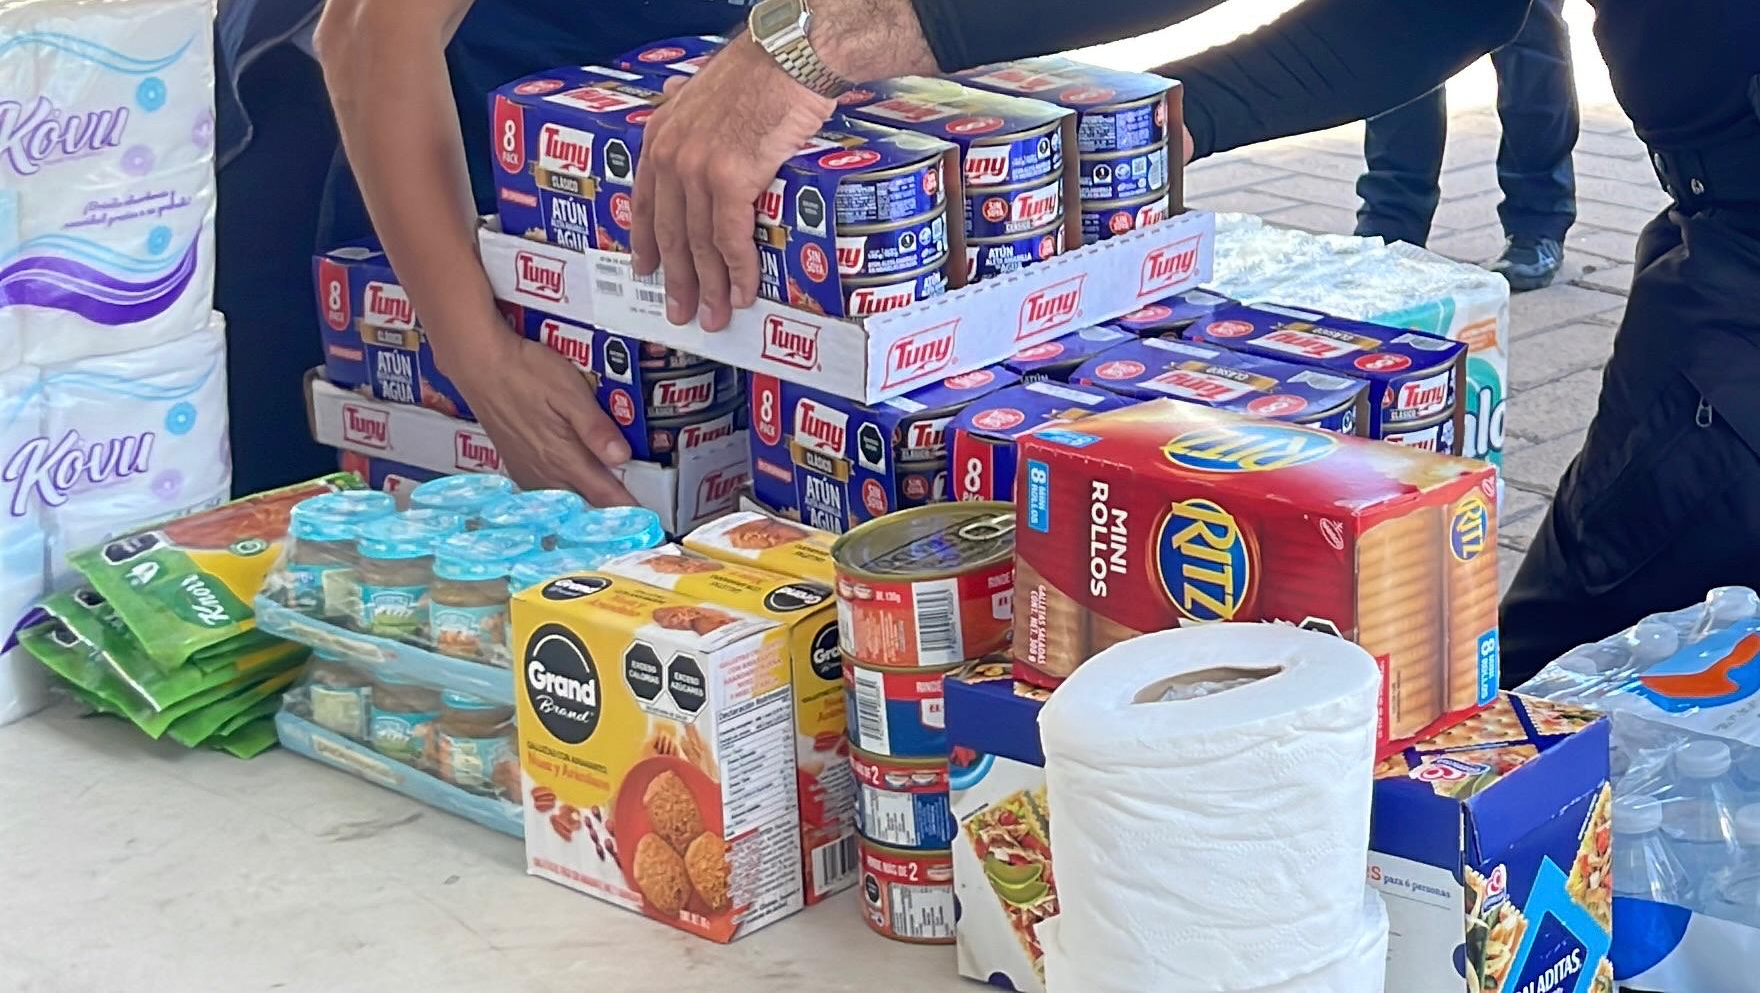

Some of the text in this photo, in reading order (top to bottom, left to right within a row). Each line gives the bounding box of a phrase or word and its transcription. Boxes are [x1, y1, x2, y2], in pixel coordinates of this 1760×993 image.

[503, 119, 516, 152] 8
[544, 126, 591, 173] Tuny
[551, 196, 588, 228] ATÚN
[520, 255, 562, 294] Tuny
[1148, 247, 1200, 284] Tuny
[329, 280, 341, 310] 8
[368, 286, 415, 325] Tuny
[1026, 286, 1082, 325] Tuny
[544, 322, 591, 368] Tuny
[768, 317, 817, 361] Tuny
[893, 330, 954, 373] Tuny
[377, 350, 412, 378] ATÚN
[382, 380, 415, 403] AGUA
[659, 382, 712, 406] Tuny
[761, 390, 773, 422] 8
[1405, 382, 1446, 409] Tuny
[346, 407, 386, 442] Tuny
[800, 402, 844, 453] Tuny
[3, 429, 155, 517] Kovu
[965, 457, 983, 493] 8
[1030, 466, 1046, 484] 8
[806, 475, 840, 509] ATÚN
[1030, 484, 1039, 524] ROLLOS
[1090, 480, 1109, 597] ROLLOS
[1110, 508, 1128, 574] MINI
[1460, 498, 1487, 560] RITZ
[1170, 501, 1235, 620] RITZ
[180, 573, 230, 626] Knorr
[1037, 584, 1047, 665] GALLETAS SALADAS
[1481, 637, 1495, 656] 8
[528, 660, 596, 707] Grand
[631, 660, 657, 673] EXCESO
[1481, 655, 1489, 700] ROLLOS
[536, 694, 591, 723] Brand
[871, 766, 881, 785] 2
[909, 862, 919, 881] 2
[1412, 880, 1451, 898] personas
